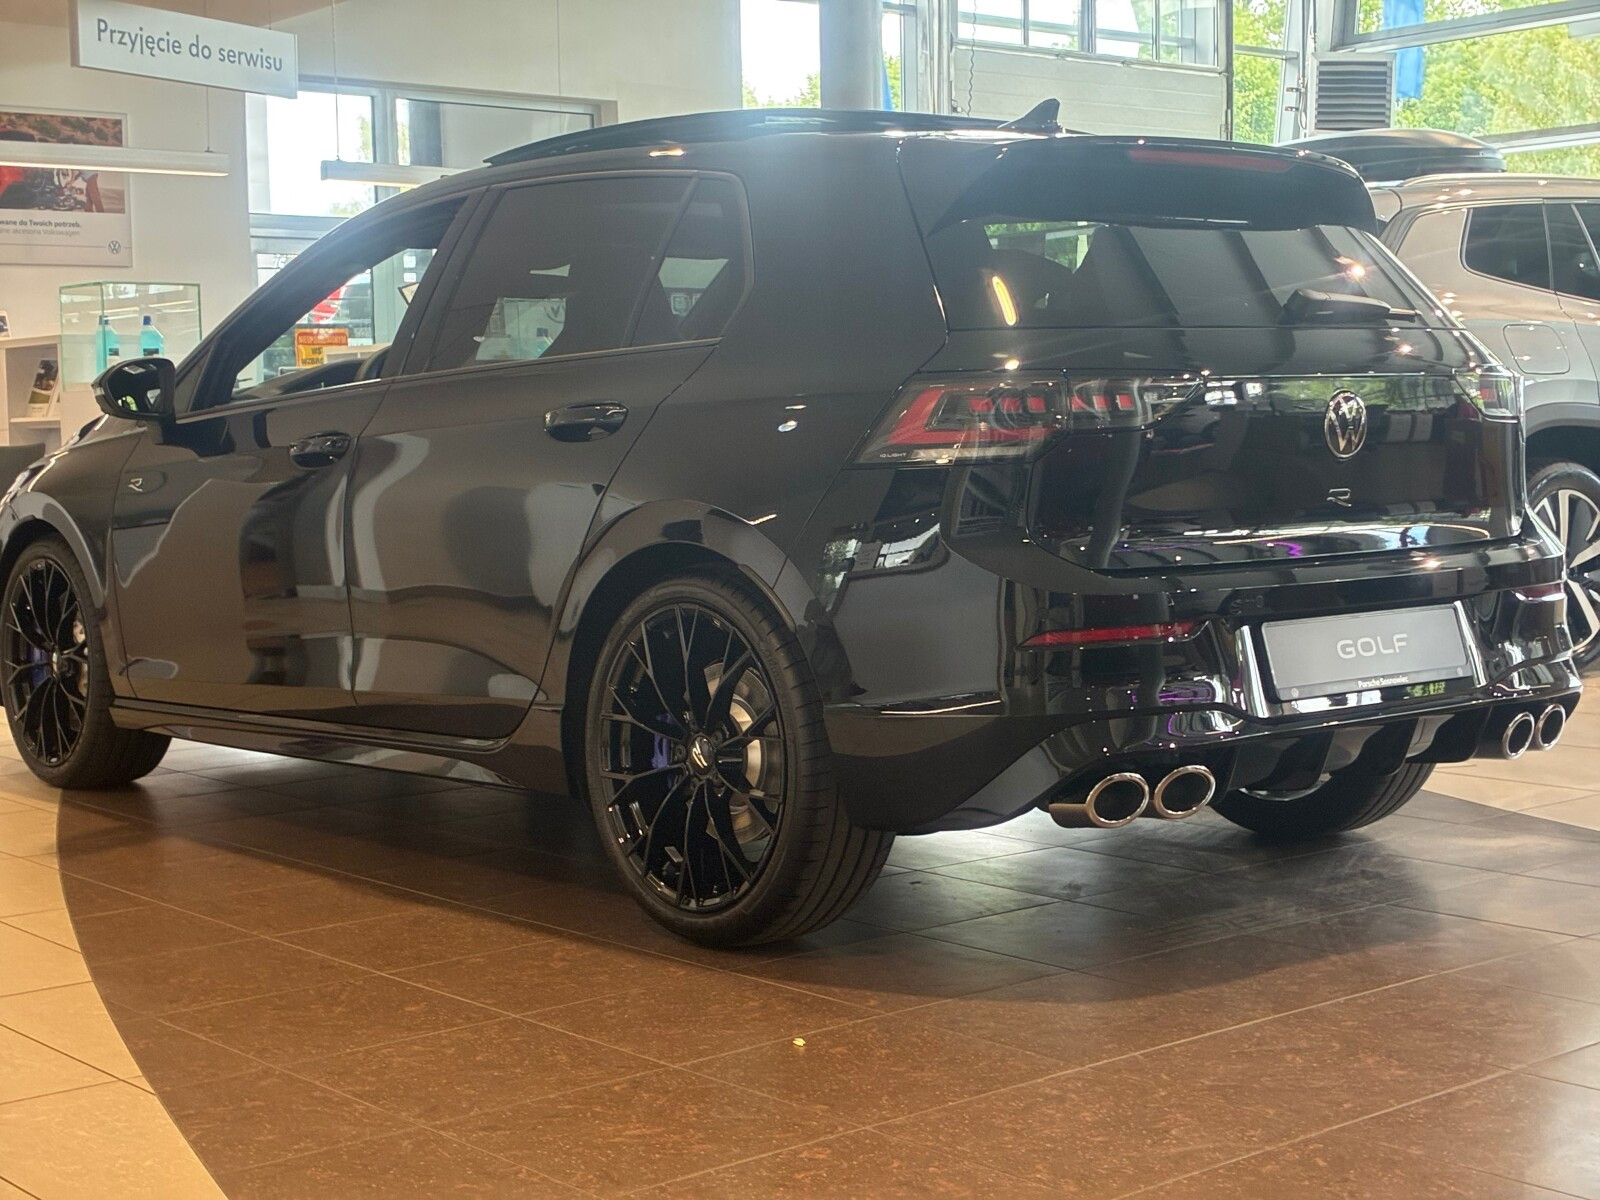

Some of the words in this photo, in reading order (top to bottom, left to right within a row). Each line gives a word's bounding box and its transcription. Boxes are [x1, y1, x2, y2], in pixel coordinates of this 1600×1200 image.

[97, 18, 182, 57] Przyjęcie
[189, 34, 212, 60] do
[218, 46, 283, 72] serwisu
[19, 219, 28, 227] do
[29, 219, 52, 228] Twoich
[54, 220, 82, 229] potrzeb.
[1326, 488, 1352, 507] R
[1336, 633, 1408, 659] GOLF
[1357, 679, 1380, 688] Porsche
[1380, 676, 1408, 686] Sosnowiec
